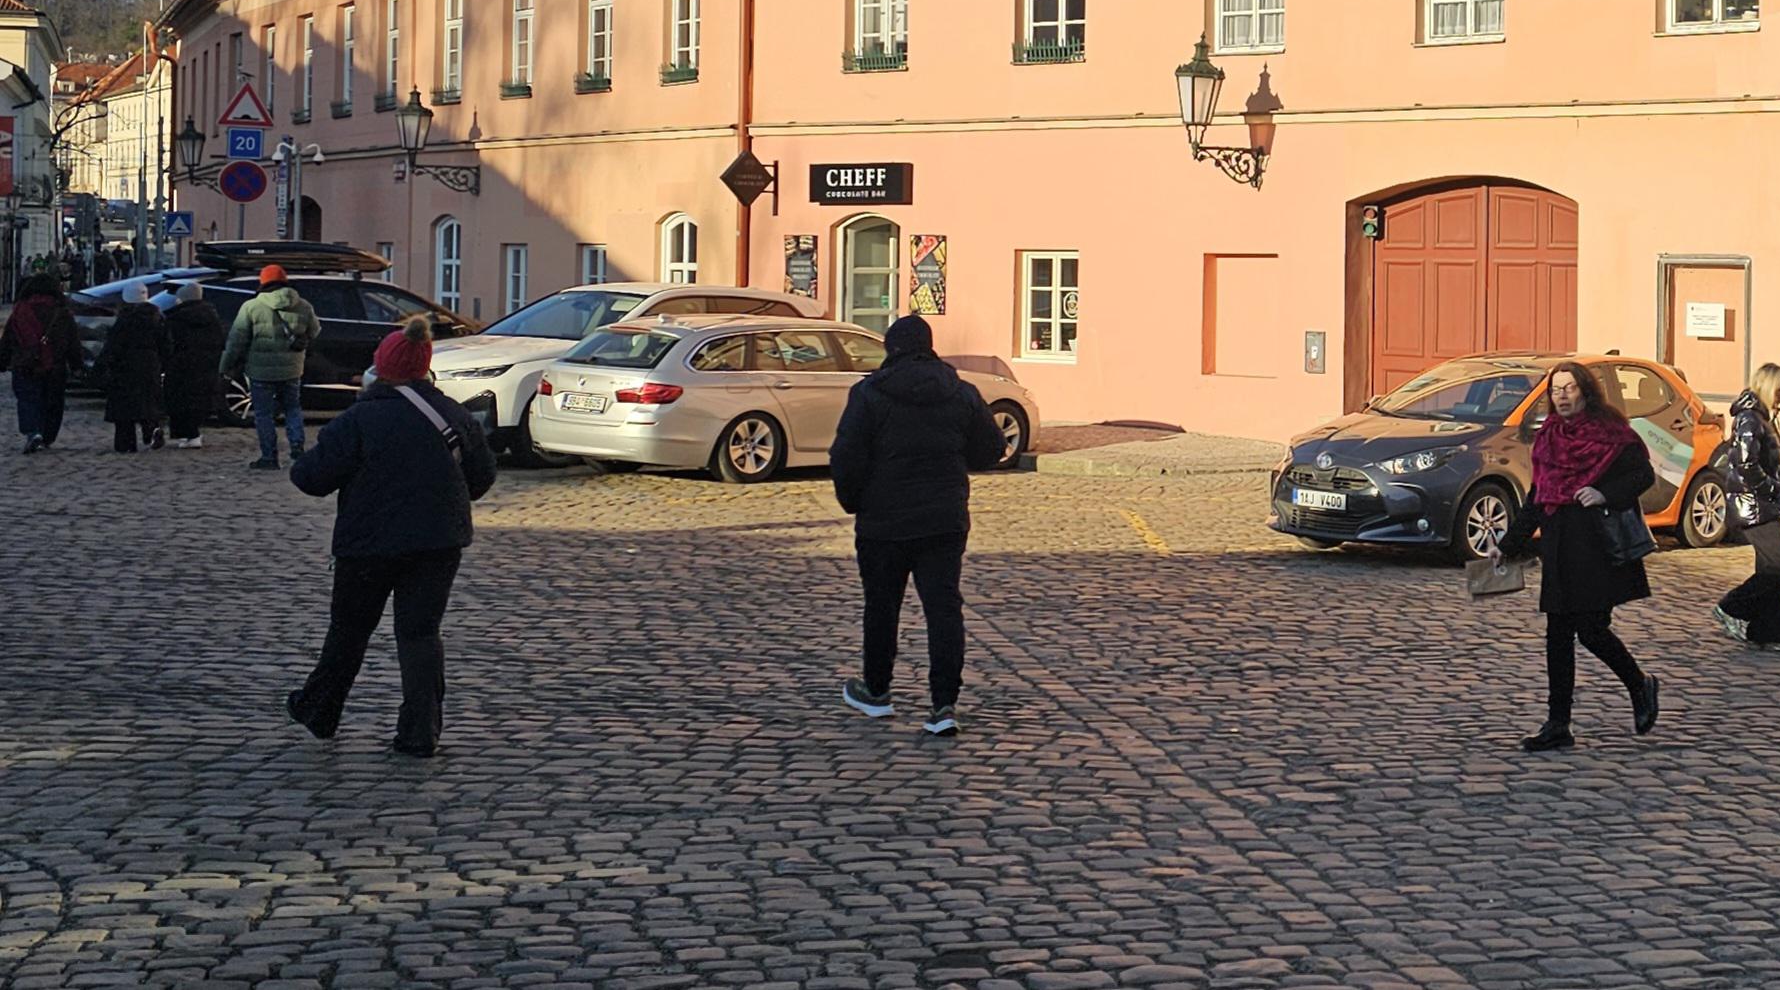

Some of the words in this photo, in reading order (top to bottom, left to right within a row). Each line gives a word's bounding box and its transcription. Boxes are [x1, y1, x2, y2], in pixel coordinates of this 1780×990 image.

[235, 136, 256, 151] 20
[826, 168, 887, 187] CHEFF
[1320, 495, 1342, 508] V400
